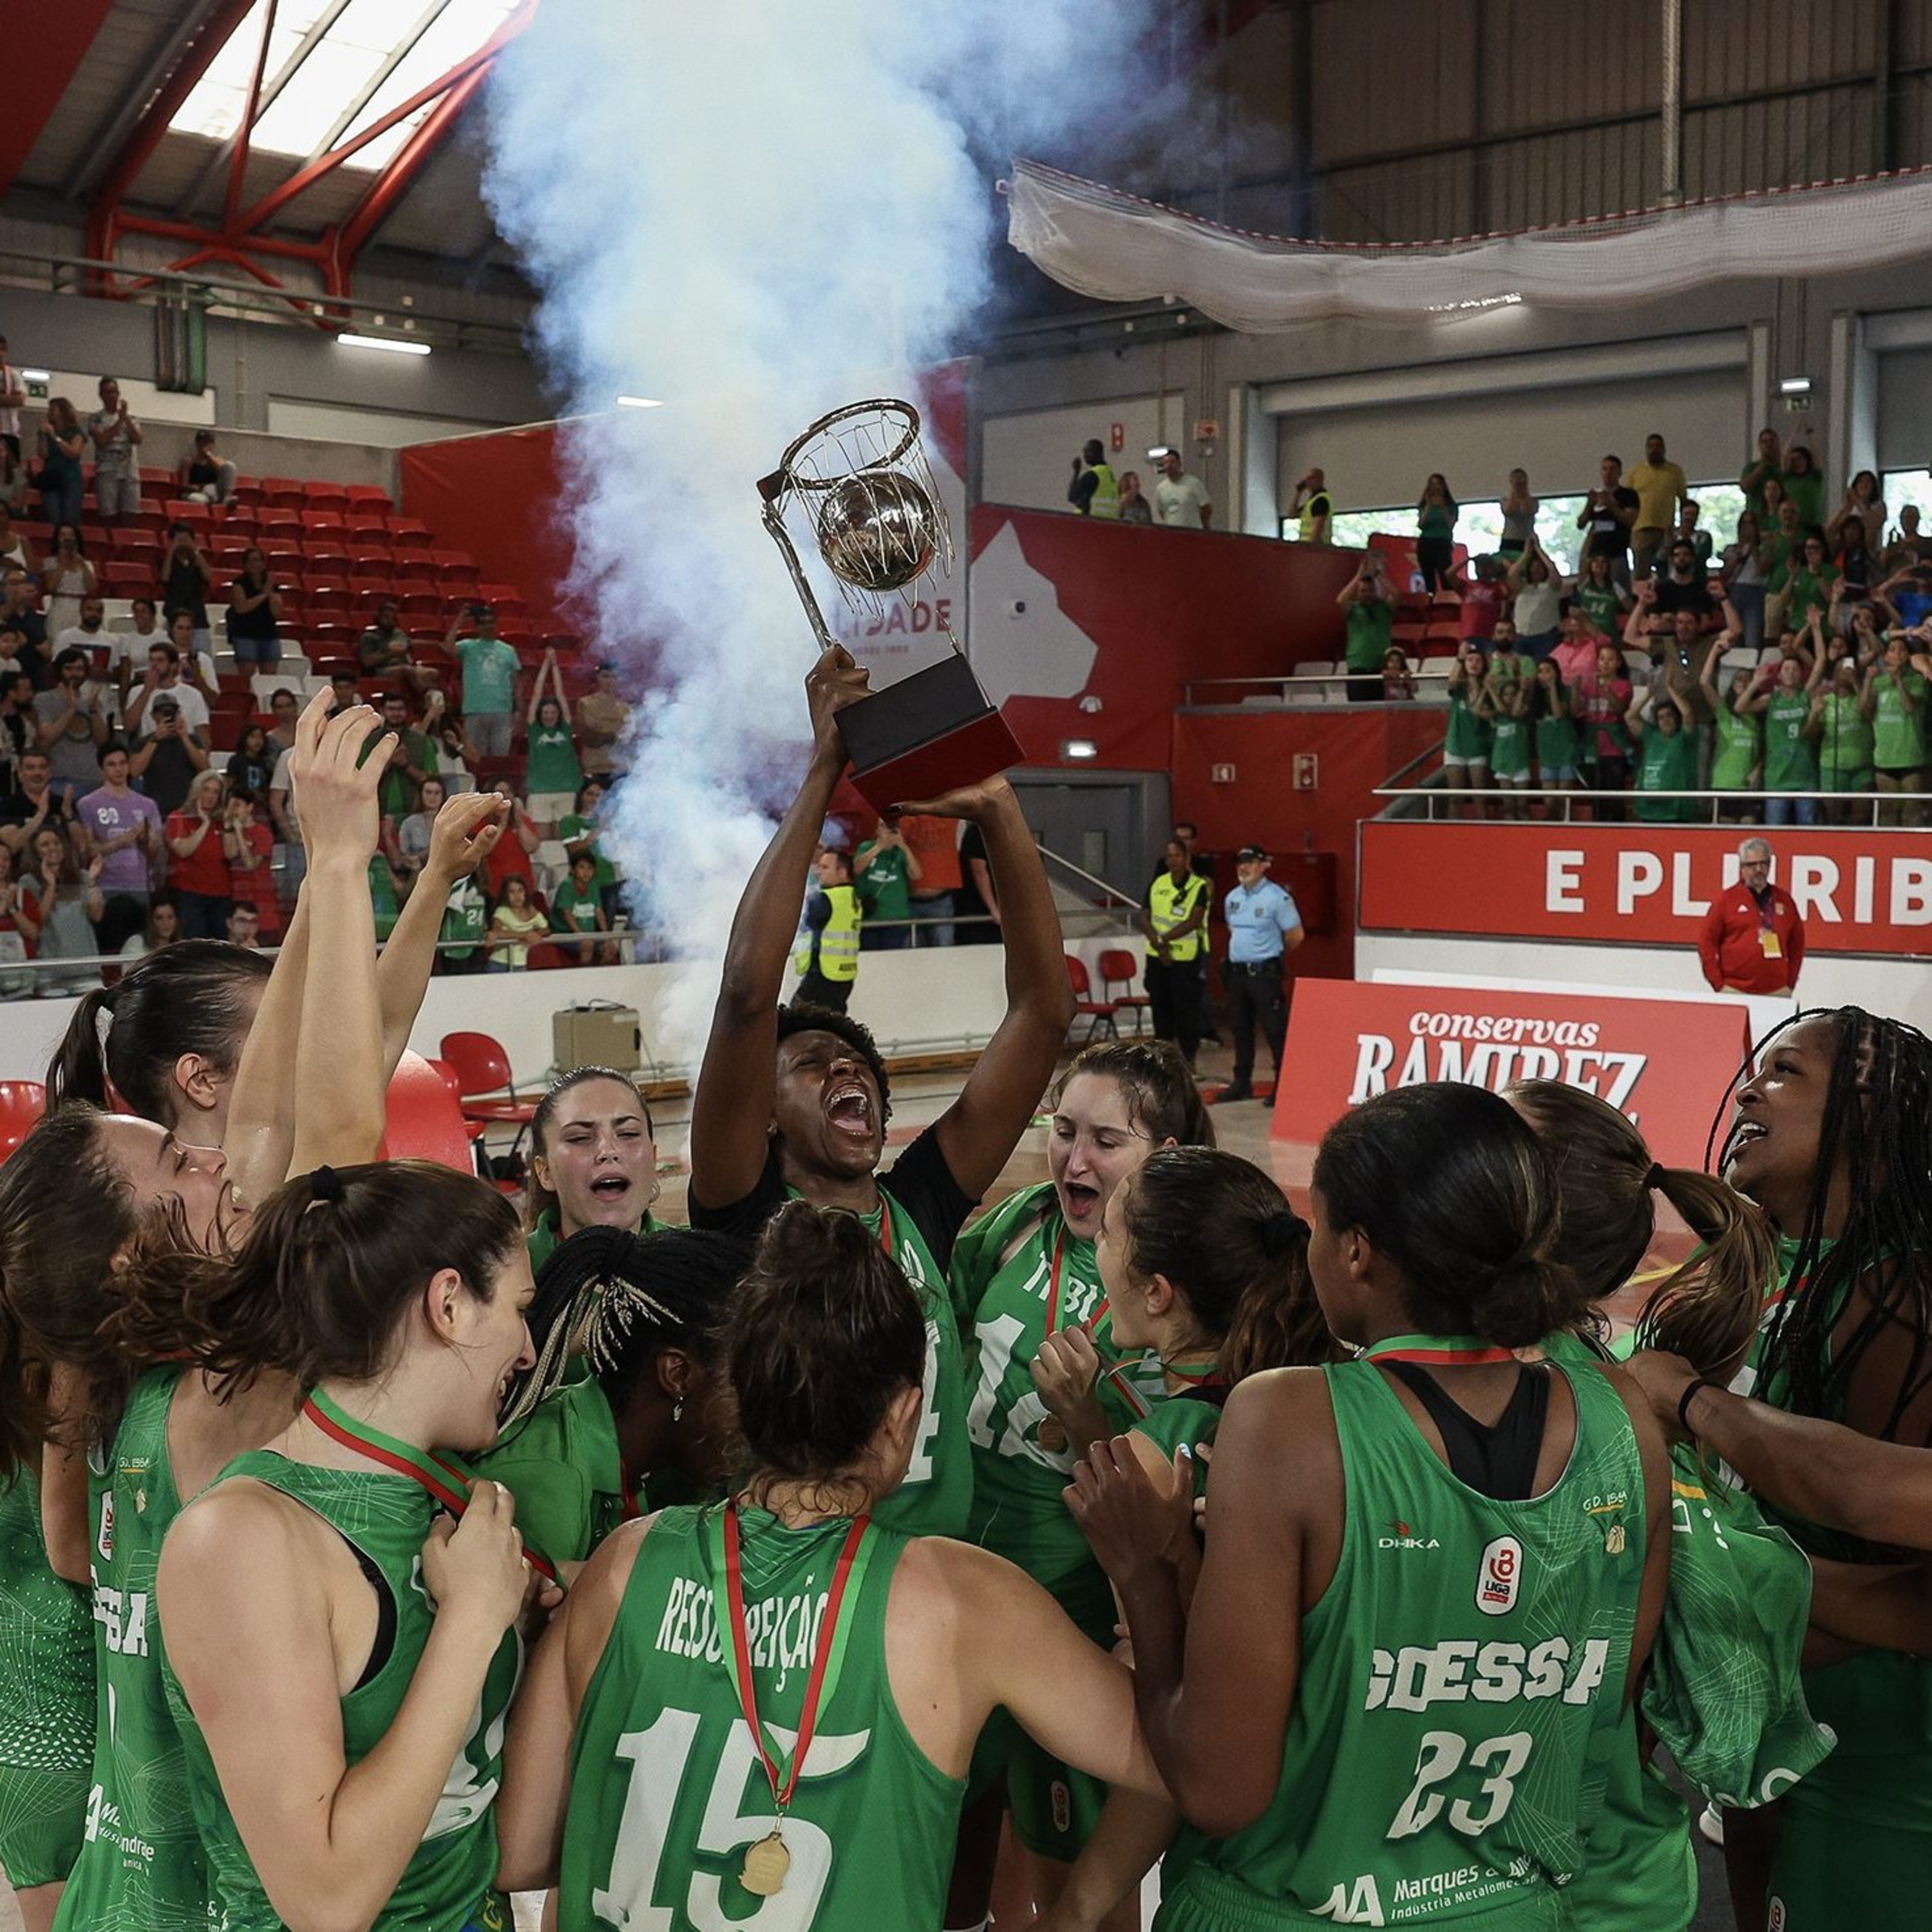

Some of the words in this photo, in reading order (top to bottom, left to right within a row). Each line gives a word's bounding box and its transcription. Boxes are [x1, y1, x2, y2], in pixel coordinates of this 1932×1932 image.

[1547, 850, 1584, 913] E
[1408, 1011, 1600, 1047] conservas
[1386, 1730, 1533, 1839] 23
[591, 1707, 871, 1932] 15
[1394, 1865, 1479, 1903] Marques
